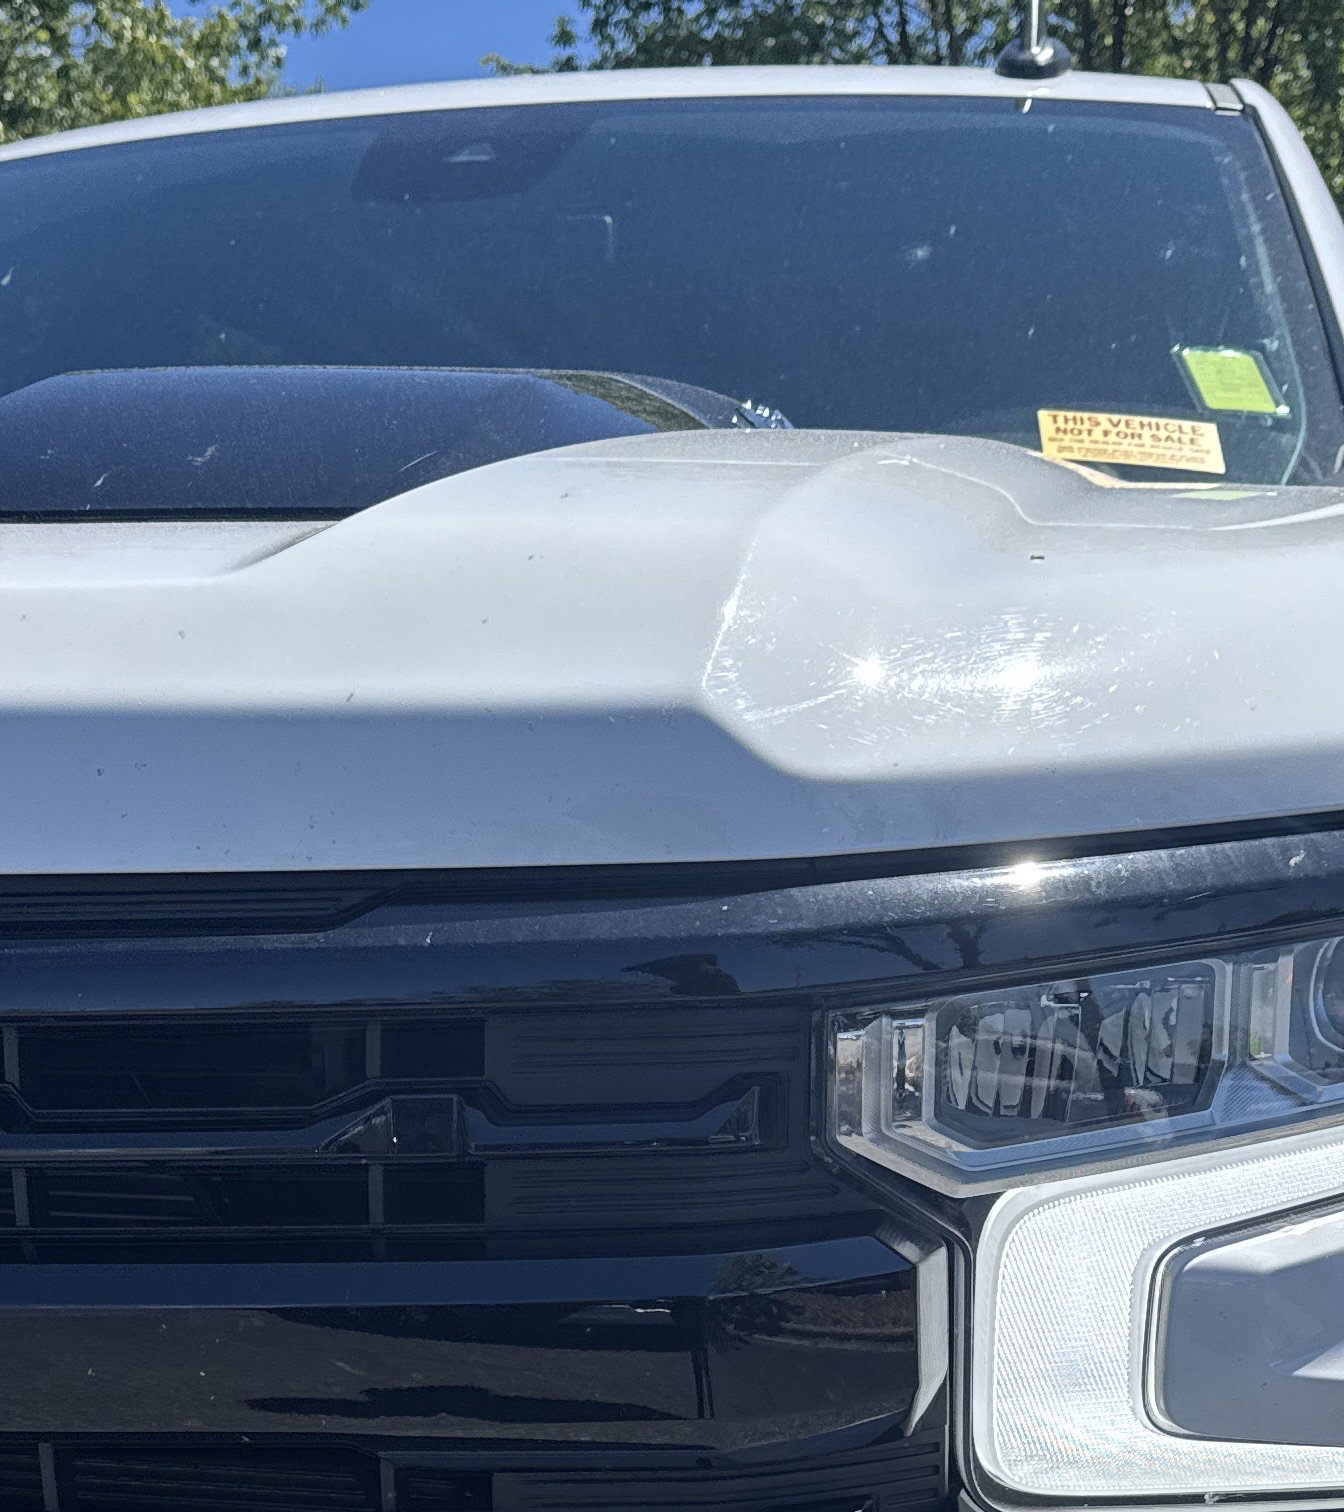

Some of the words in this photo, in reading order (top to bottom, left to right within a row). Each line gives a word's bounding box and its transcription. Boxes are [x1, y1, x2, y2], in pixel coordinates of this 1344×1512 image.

[1048, 414, 1102, 427] THIS
[1107, 417, 1204, 436] VEHICLE
[1055, 426, 1094, 437] NOT
[1103, 429, 1143, 440] FOR
[1150, 434, 1202, 446] SALE
